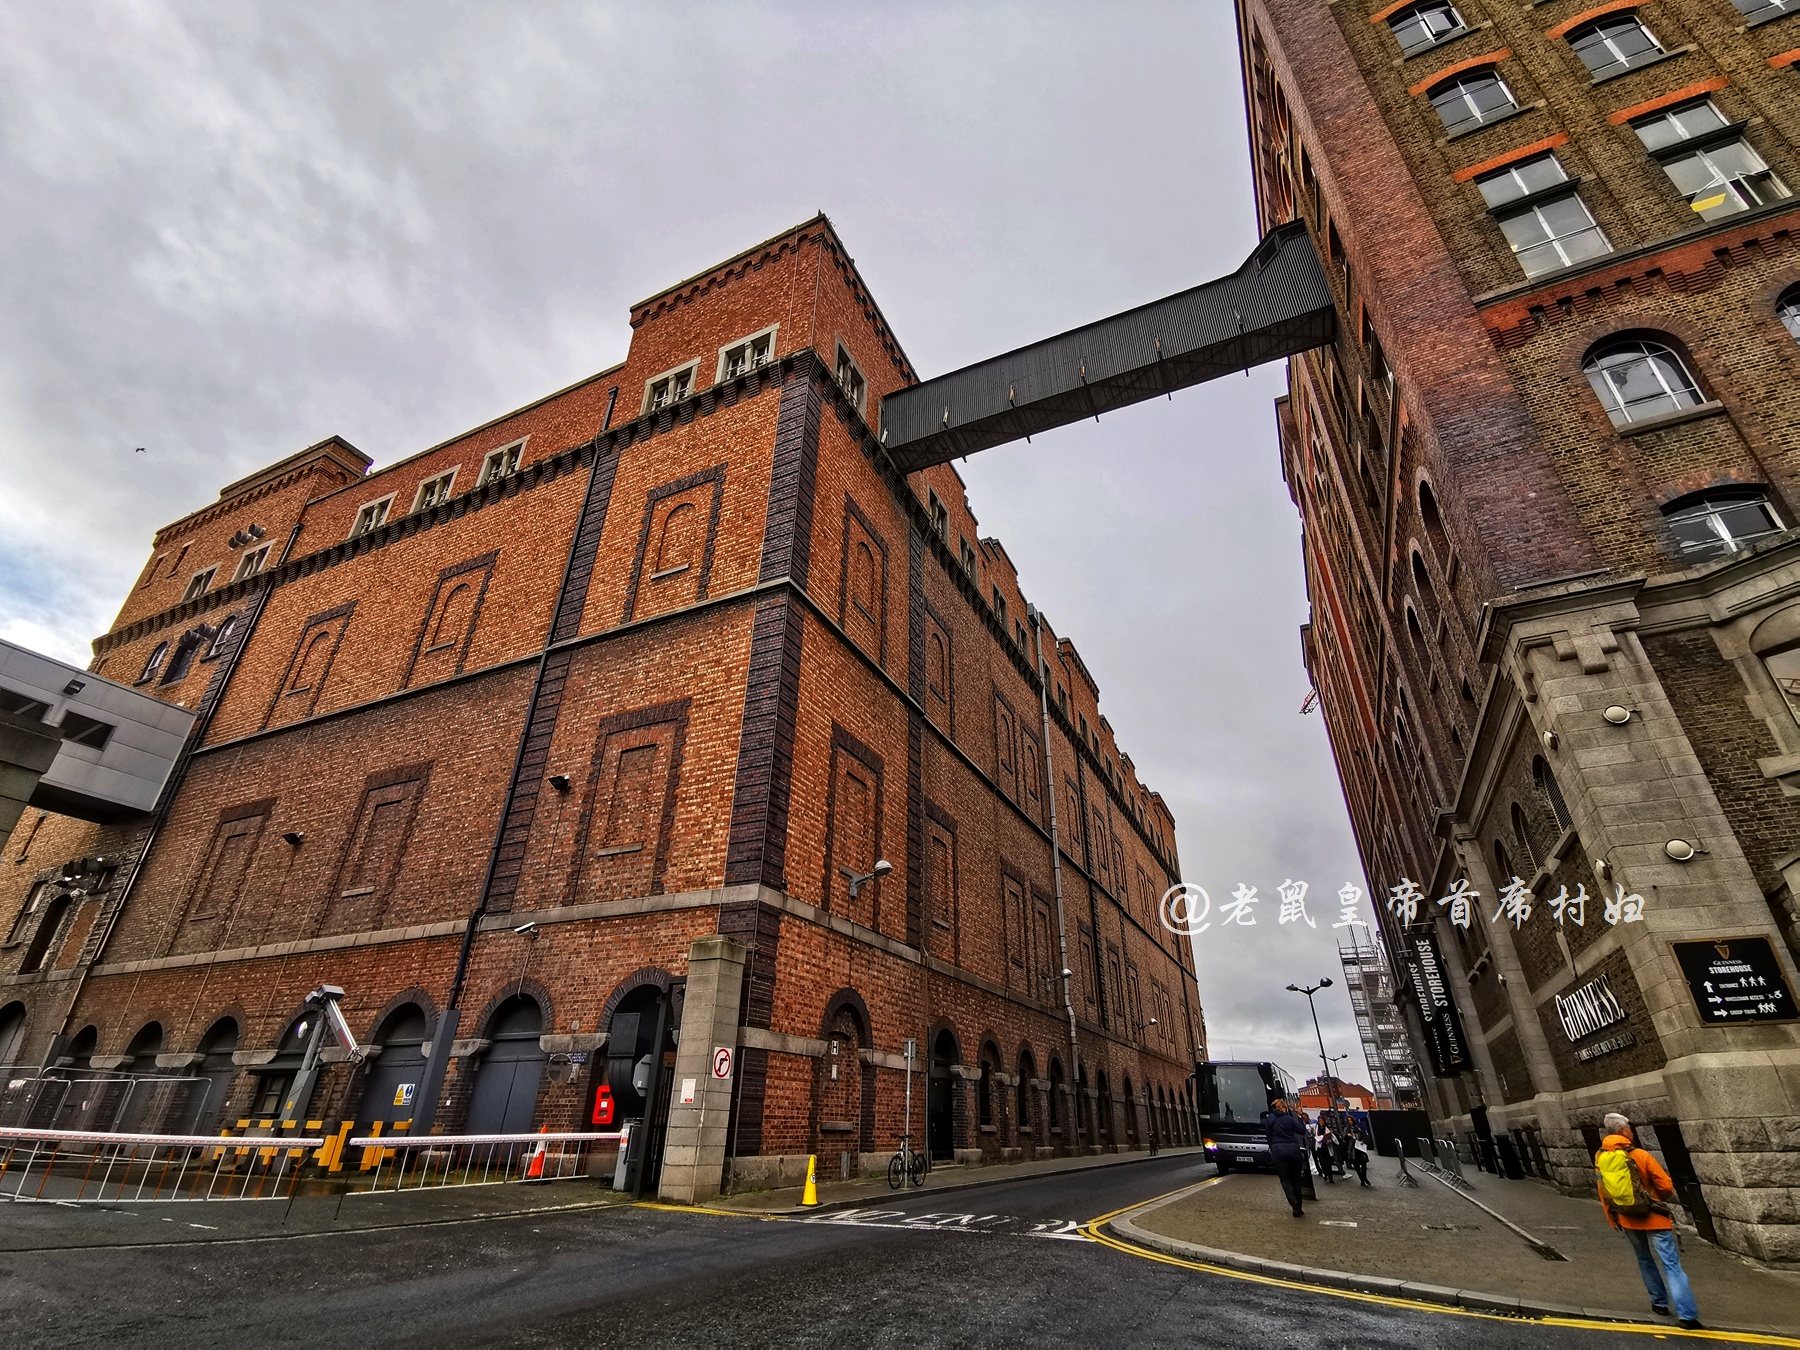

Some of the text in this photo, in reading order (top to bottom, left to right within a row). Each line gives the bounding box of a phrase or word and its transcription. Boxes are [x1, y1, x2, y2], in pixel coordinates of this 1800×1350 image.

[1415, 939, 1448, 1007] STOREHOUSE
[1708, 964, 1753, 974] STOREHOUSE
[1442, 1013, 1459, 1054] GUINNESS
[809, 1209, 905, 1221] NO
